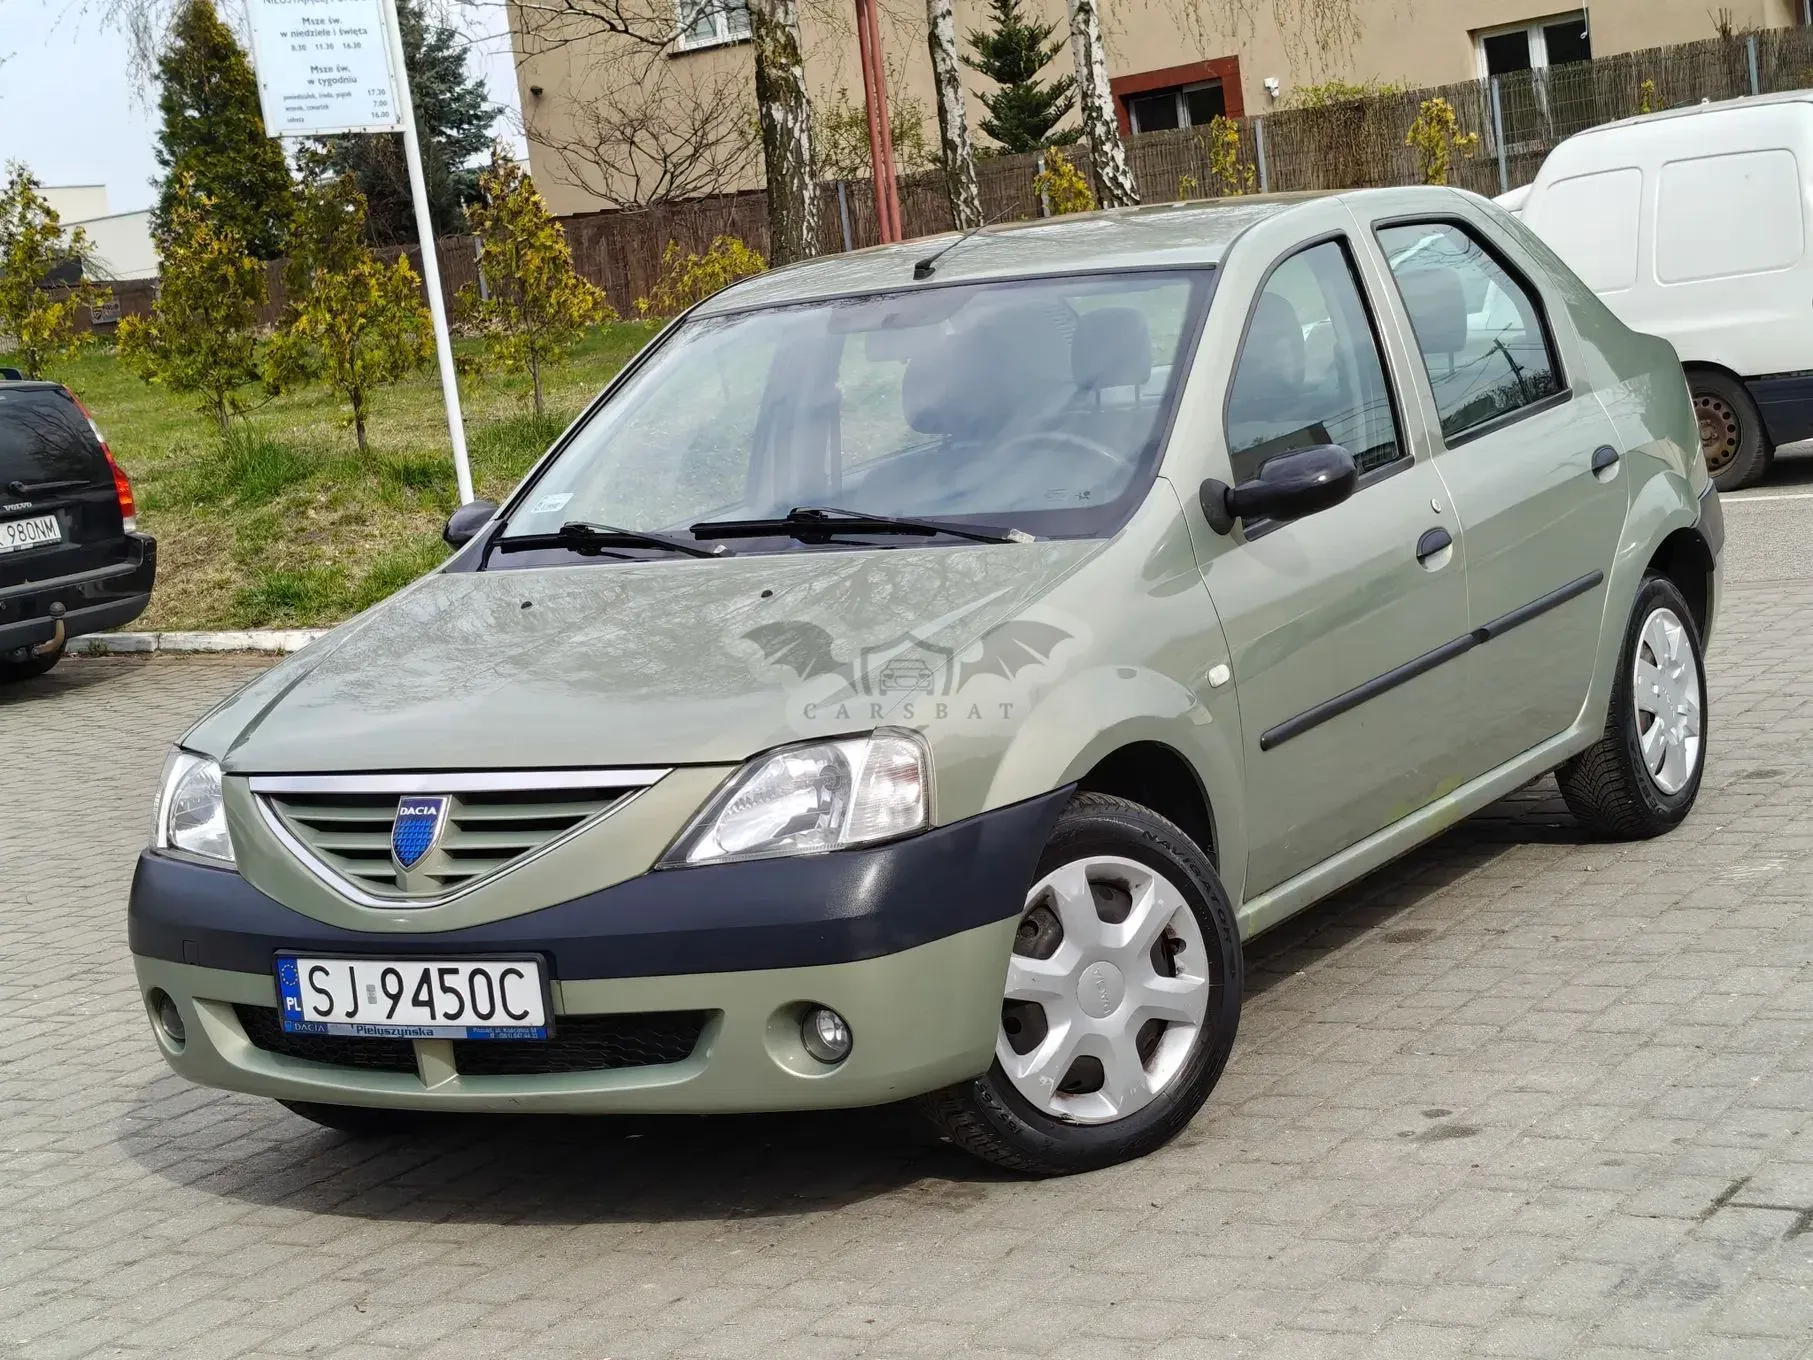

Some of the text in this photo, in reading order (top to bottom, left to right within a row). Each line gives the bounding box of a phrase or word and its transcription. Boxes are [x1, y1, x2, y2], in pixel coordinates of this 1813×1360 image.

[302, 16, 342, 25] Msze św.
[291, 28, 331, 37] niedziele
[339, 27, 368, 37] święta
[310, 64, 351, 74] Msze św.
[317, 76, 358, 87] tygodniu
[371, 111, 390, 119] 16.00
[7, 518, 57, 545] 980NM
[400, 806, 437, 816] DACIA
[308, 965, 530, 1021] SJ 9450C
[287, 996, 302, 1012] PL
[294, 1023, 325, 1032] DACIA
